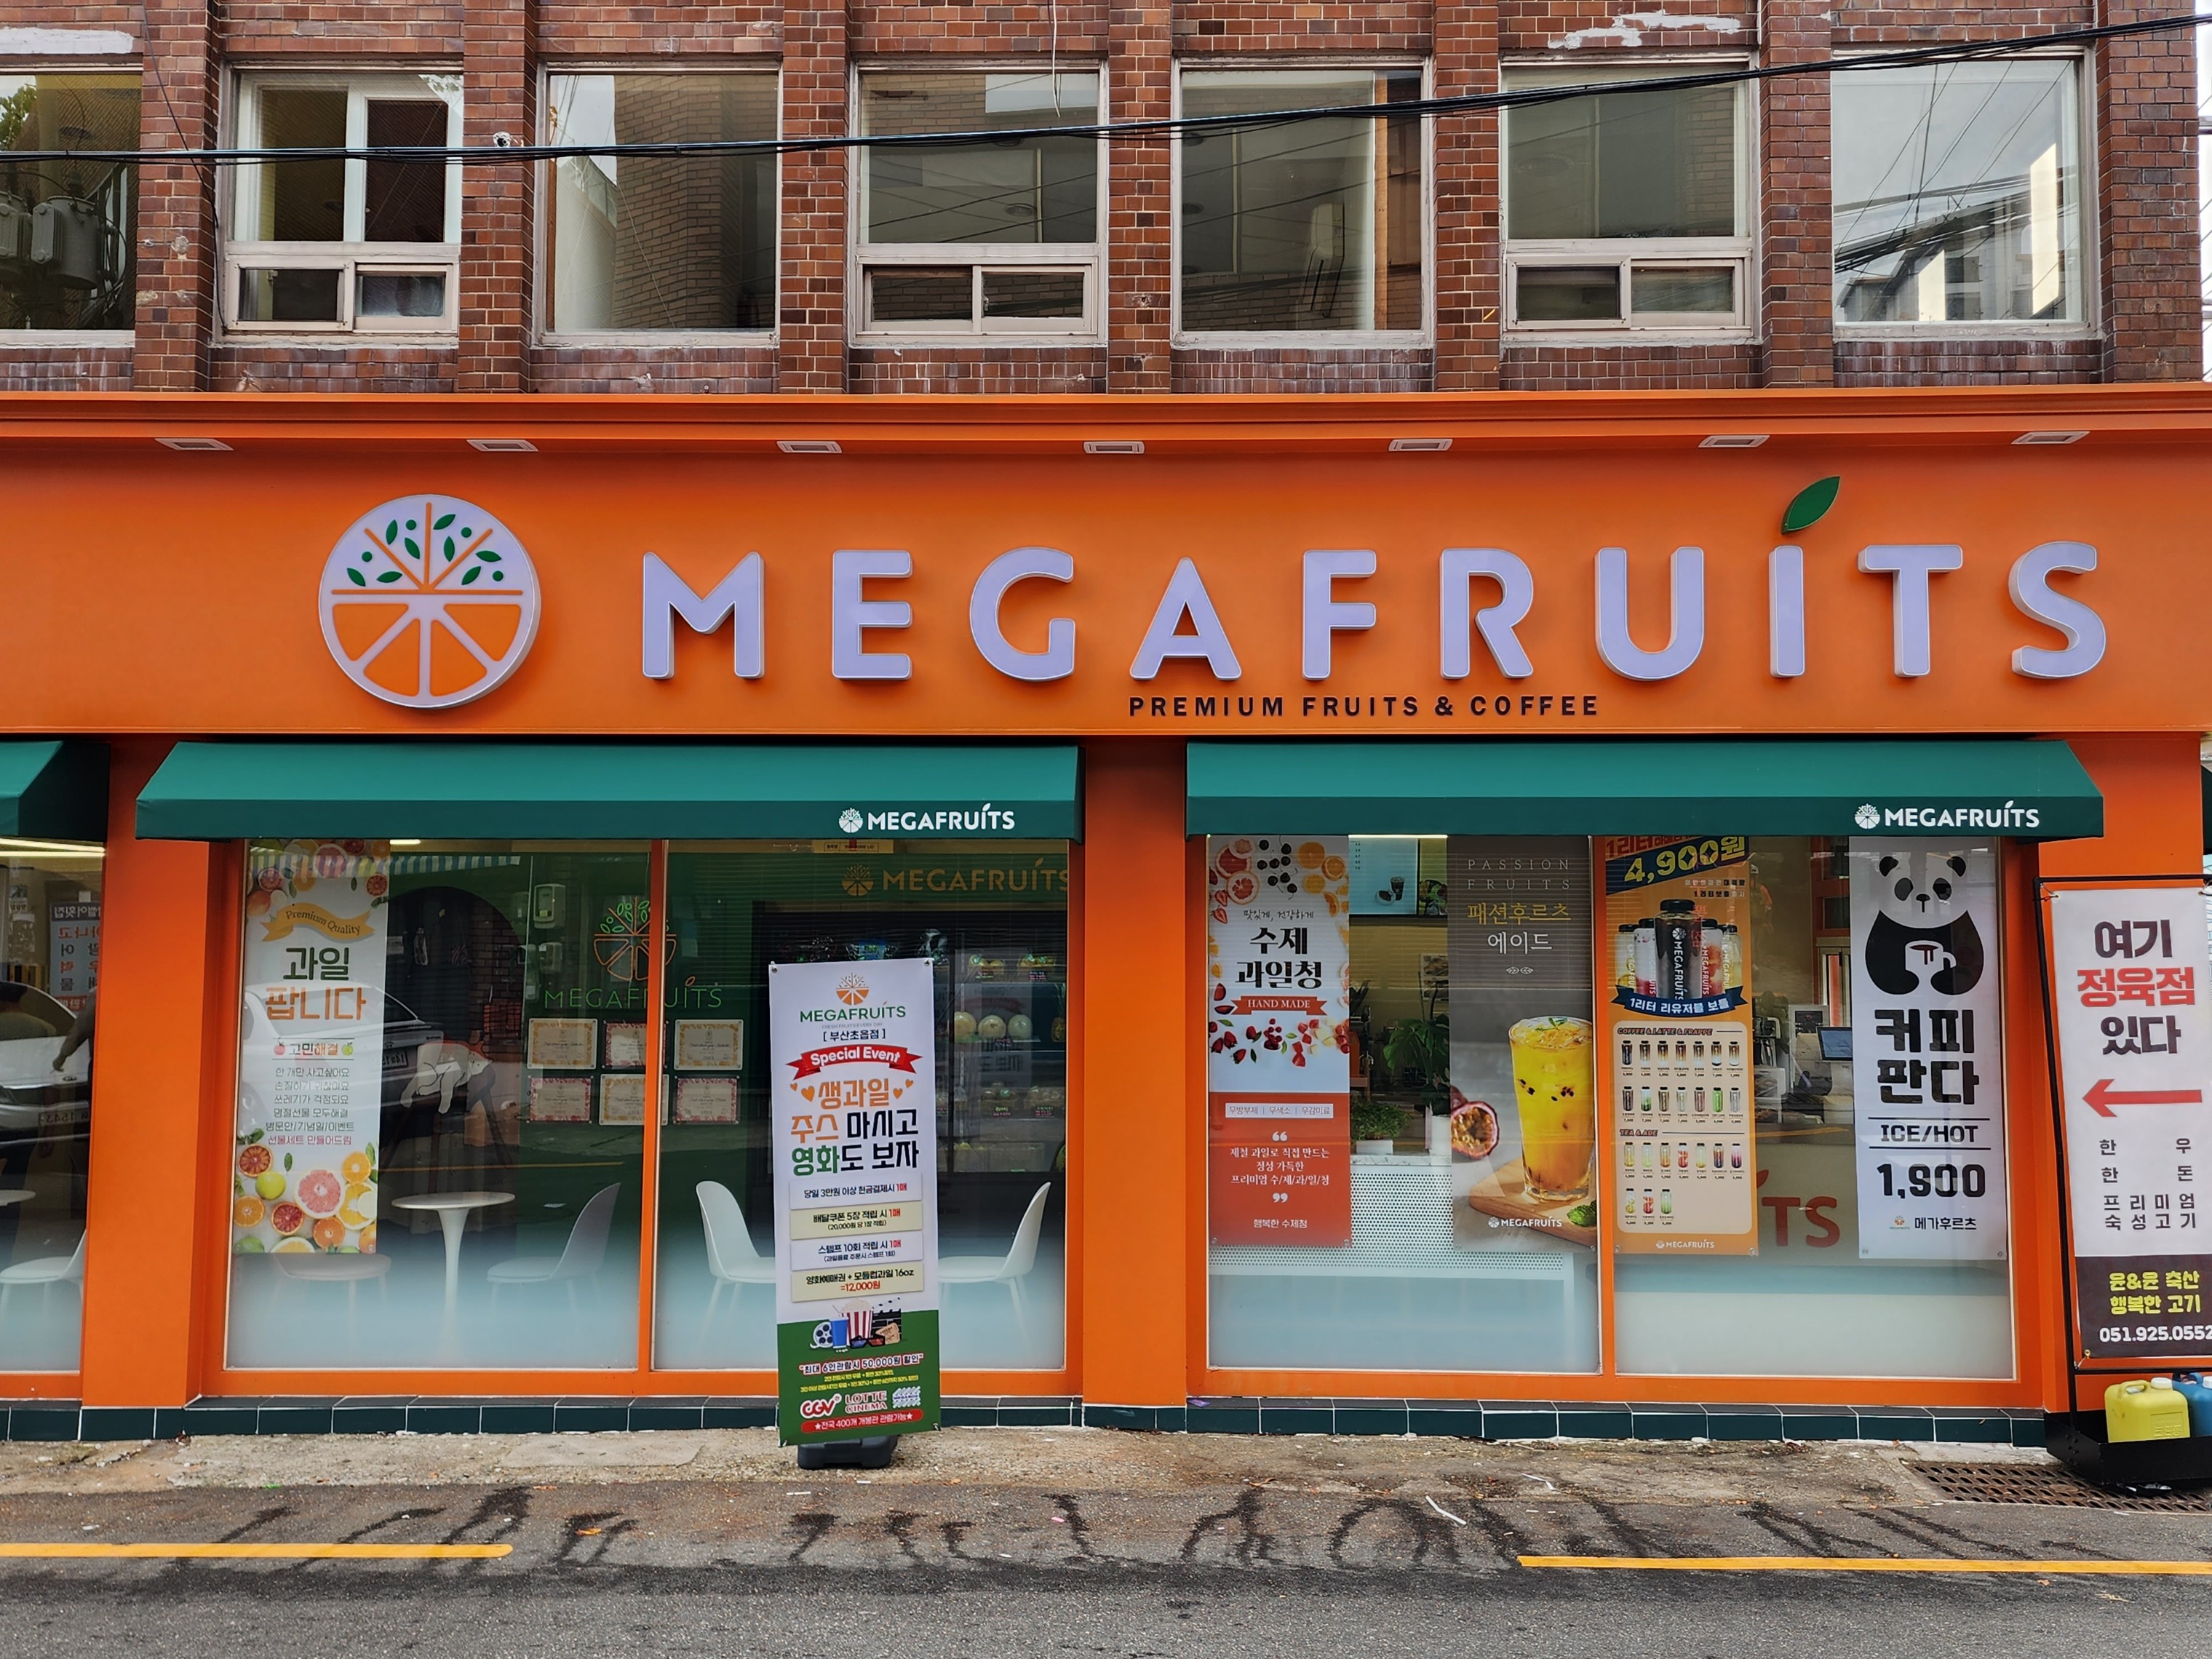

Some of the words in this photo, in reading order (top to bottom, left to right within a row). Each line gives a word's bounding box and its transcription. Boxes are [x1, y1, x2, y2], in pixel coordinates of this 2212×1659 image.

[642, 477, 2106, 682] MEGAFRUITS
[1129, 696, 1284, 717] PREMIUM
[1302, 696, 1419, 717] FRUITS
[1434, 696, 1454, 717] &
[1470, 695, 1599, 717] COFFEE
[867, 803, 1016, 831] MEGAFRUITS
[1885, 800, 2040, 828] MEGAFRUITS
[1468, 859, 1570, 870] PASSION
[1624, 837, 1746, 883] 4,900원
[1468, 879, 1570, 890] FRUITS
[286, 910, 327, 926] Premium
[327, 920, 361, 936] Quality
[1243, 909, 1274, 922] 맛있게,
[1277, 909, 1314, 920] 건강하게
[1467, 902, 1572, 926] 패션후르츠
[1250, 927, 1308, 955] 수제
[1487, 931, 1553, 955] 에이드
[2094, 919, 2173, 959] 여기
[282, 947, 349, 980] 과일
[1702, 949, 1713, 995] MEGAFRUITS
[1235, 960, 1322, 990] 과일청
[545, 976, 723, 1008] MEGAFUITS
[2077, 966, 2196, 1008] 정육점
[265, 987, 367, 1020] 팝니다
[800, 1001, 907, 1022] MEGAFRUITS
[1248, 999, 1278, 1008] HAND
[1281, 1000, 1310, 1008] MADE
[1630, 998, 1656, 1012] 1리터
[1660, 1002, 1704, 1014] 리유저블
[1707, 998, 1730, 1012] 보틀
[830, 1029, 879, 1041] 부산초읍점
[1617, 1027, 1645, 1035] COFFEE
[1652, 1027, 1676, 1035] LATTE
[1684, 1028, 1713, 1036] FRAPPE
[1874, 1008, 1975, 1054] 커피
[2101, 1015, 2181, 1056] 있다
[288, 1043, 338, 1056] 고민해결
[810, 1046, 860, 1066] Special
[863, 1046, 901, 1064] Event
[306, 1067, 349, 1077] 사고싶어요
[1877, 1059, 1980, 1105] 판다
[274, 1094, 310, 1105] 쓰레기가
[314, 1094, 349, 1105] 걱정되요
[818, 1078, 889, 1110] 생과일
[313, 1108, 349, 1118] 모두해결
[1229, 1107, 1258, 1115] 무방부제
[1269, 1107, 1291, 1115] 무색소
[1302, 1107, 1330, 1115] 무감미료
[791, 1114, 839, 1143] 주스
[847, 1109, 919, 1139] 마시고
[1620, 1129, 1634, 1137] TEA
[1642, 1129, 1658, 1137] ADE
[1880, 1124, 1978, 1142] ICE/HOT
[268, 1135, 304, 1145] 선물세트
[307, 1135, 352, 1145] 만들어드림
[792, 1145, 864, 1176] 영화도
[872, 1140, 920, 1169] 보자
[1230, 1147, 1249, 1158] 제철
[1251, 1147, 1279, 1158] 과일로
[1282, 1147, 1300, 1158] 직접
[1302, 1147, 1330, 1158] 만드는
[1257, 1161, 1274, 1172] 정성
[1276, 1161, 1305, 1172] 가득한
[1230, 1175, 1268, 1185] 프리미엄
[1270, 1174, 1330, 1186] 수/제/과/일/청
[1877, 1163, 1986, 1198] 1,900
[804, 1189, 819, 1198] 당일
[820, 1187, 840, 1197] 3만원
[842, 1186, 857, 1195] 이상
[858, 1183, 895, 1195] 현금결제시
[896, 1183, 907, 1191] 1매
[813, 1213, 845, 1223] 배달쿠폰
[847, 1212, 861, 1221] 5장
[862, 1209, 878, 1220] 적립
[880, 1209, 887, 1218] 시
[888, 1208, 901, 1217] 1매
[1253, 1219, 1280, 1229] 행복한
[1281, 1219, 1308, 1229] 수제청
[1501, 1216, 1562, 1228] MEGAFRUITS
[1914, 1217, 1977, 1230] 메가후르츠
[843, 1243, 861, 1252] 10회
[862, 1241, 878, 1251] 적립
[880, 1241, 888, 1249] 시
[889, 1239, 902, 1249] 1매
[1666, 1238, 1715, 1249] MEGAFRUITS
[805, 1273, 846, 1285] 영화예매권
[894, 1268, 915, 1278] 16oz
[2109, 1271, 2159, 1292] 윤&윤
[2165, 1270, 2200, 1290] 축산
[840, 1280, 880, 1292] =12,000원
[2110, 1294, 2162, 1315] 행복한
[2168, 1294, 2201, 1313] 고기
[2099, 1324, 2212, 1342] 051.925.0552
[822, 1361, 859, 1373] 6인관람시
[862, 1358, 901, 1369] 50,000원
[801, 1396, 838, 1417] CGV
[845, 1391, 887, 1404] LOTTE
[844, 1402, 888, 1414] CINEMA
[821, 1420, 835, 1431] 전국
[835, 1418, 857, 1428] 400개
